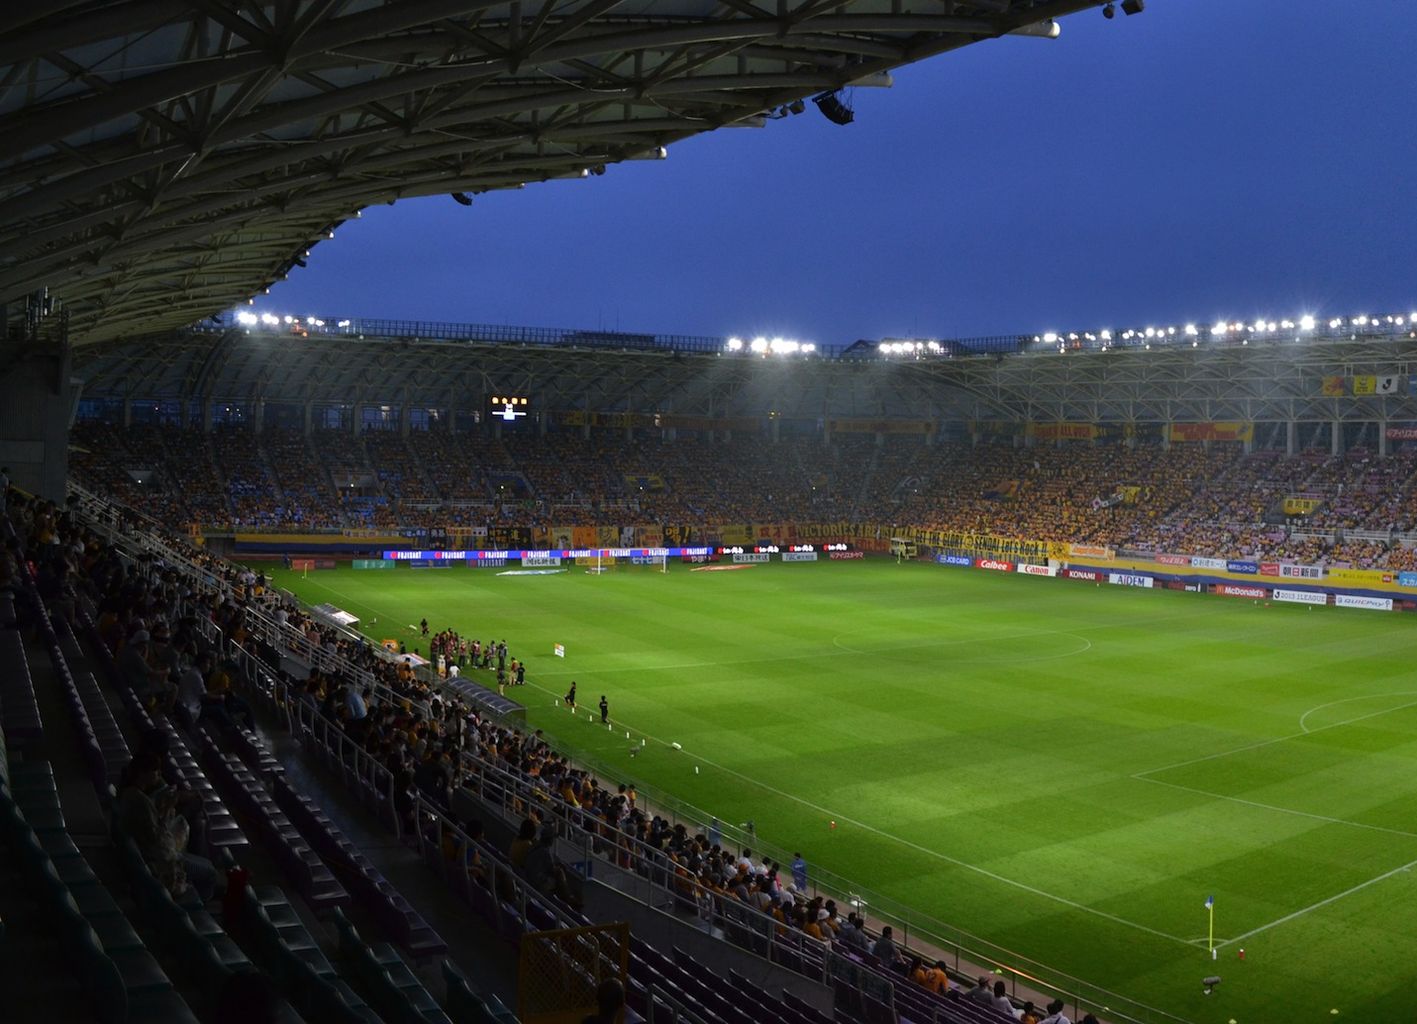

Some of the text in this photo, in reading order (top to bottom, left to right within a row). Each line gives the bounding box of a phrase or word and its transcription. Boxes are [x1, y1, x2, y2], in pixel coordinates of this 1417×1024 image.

[980, 560, 1008, 571] Calbee
[1024, 566, 1049, 575] Canon
[1068, 571, 1096, 580] KONAMI
[1224, 586, 1264, 598] McDonald's
